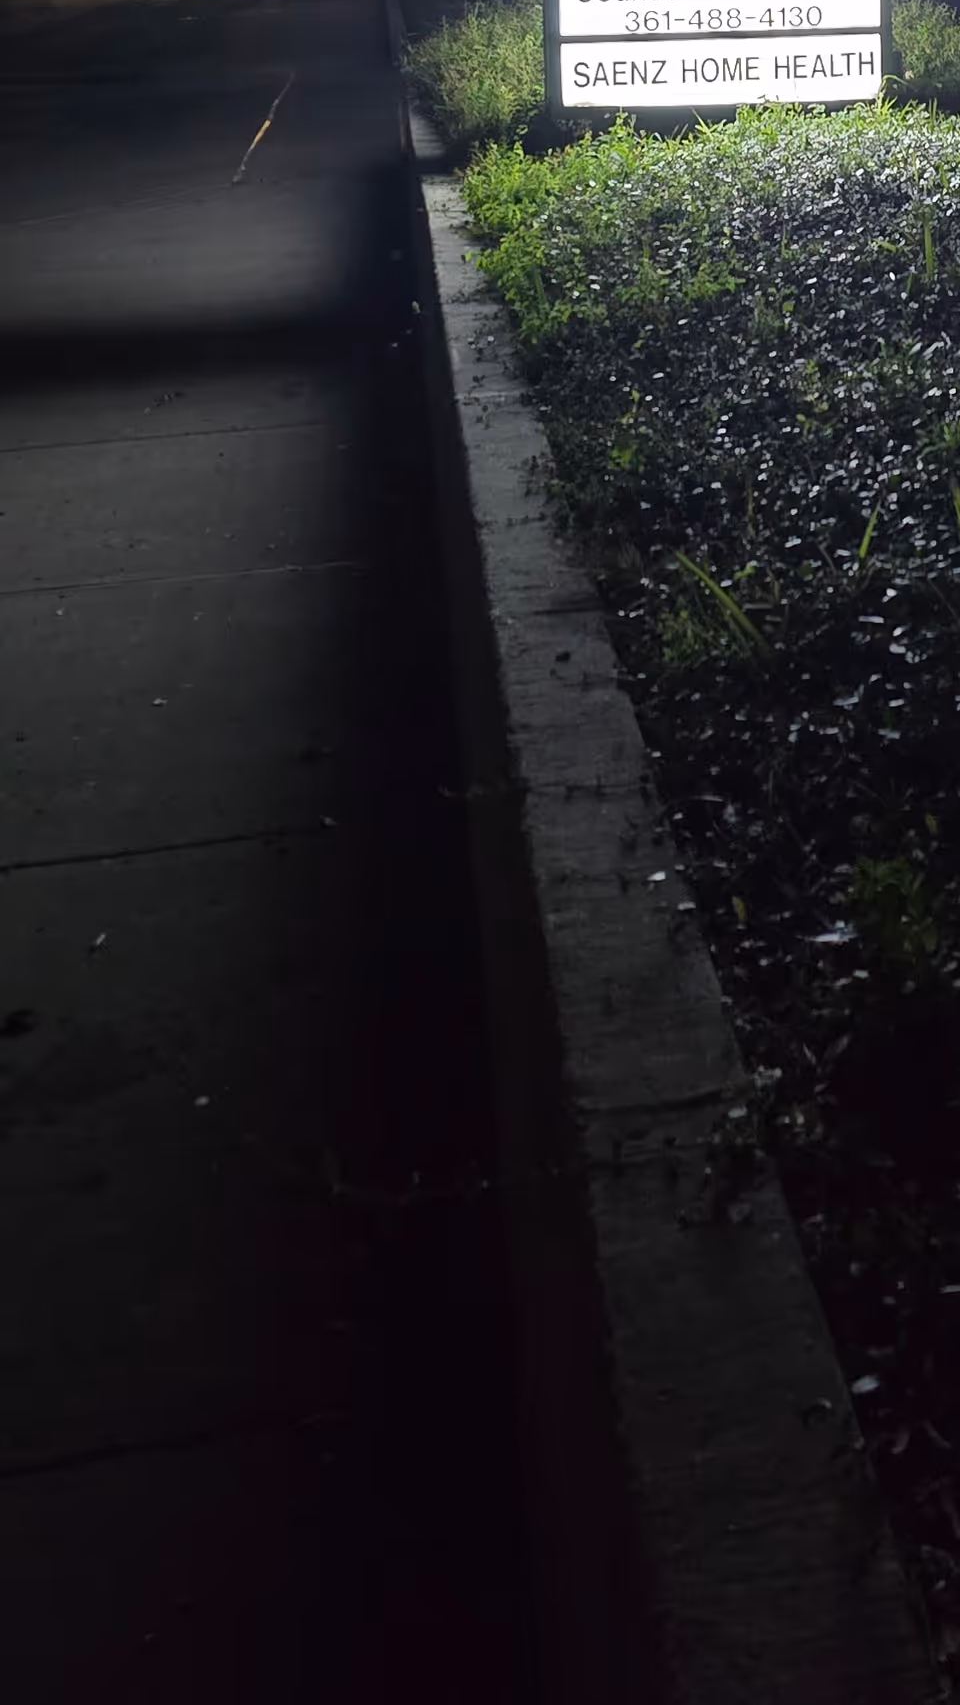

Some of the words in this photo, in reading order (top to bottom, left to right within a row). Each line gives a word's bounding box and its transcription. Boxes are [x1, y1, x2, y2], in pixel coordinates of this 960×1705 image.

[624, 6, 823, 32] 361-488-4130
[574, 60, 668, 88] SAENZ
[682, 57, 760, 83] HOME
[775, 51, 874, 79] HEALTH
